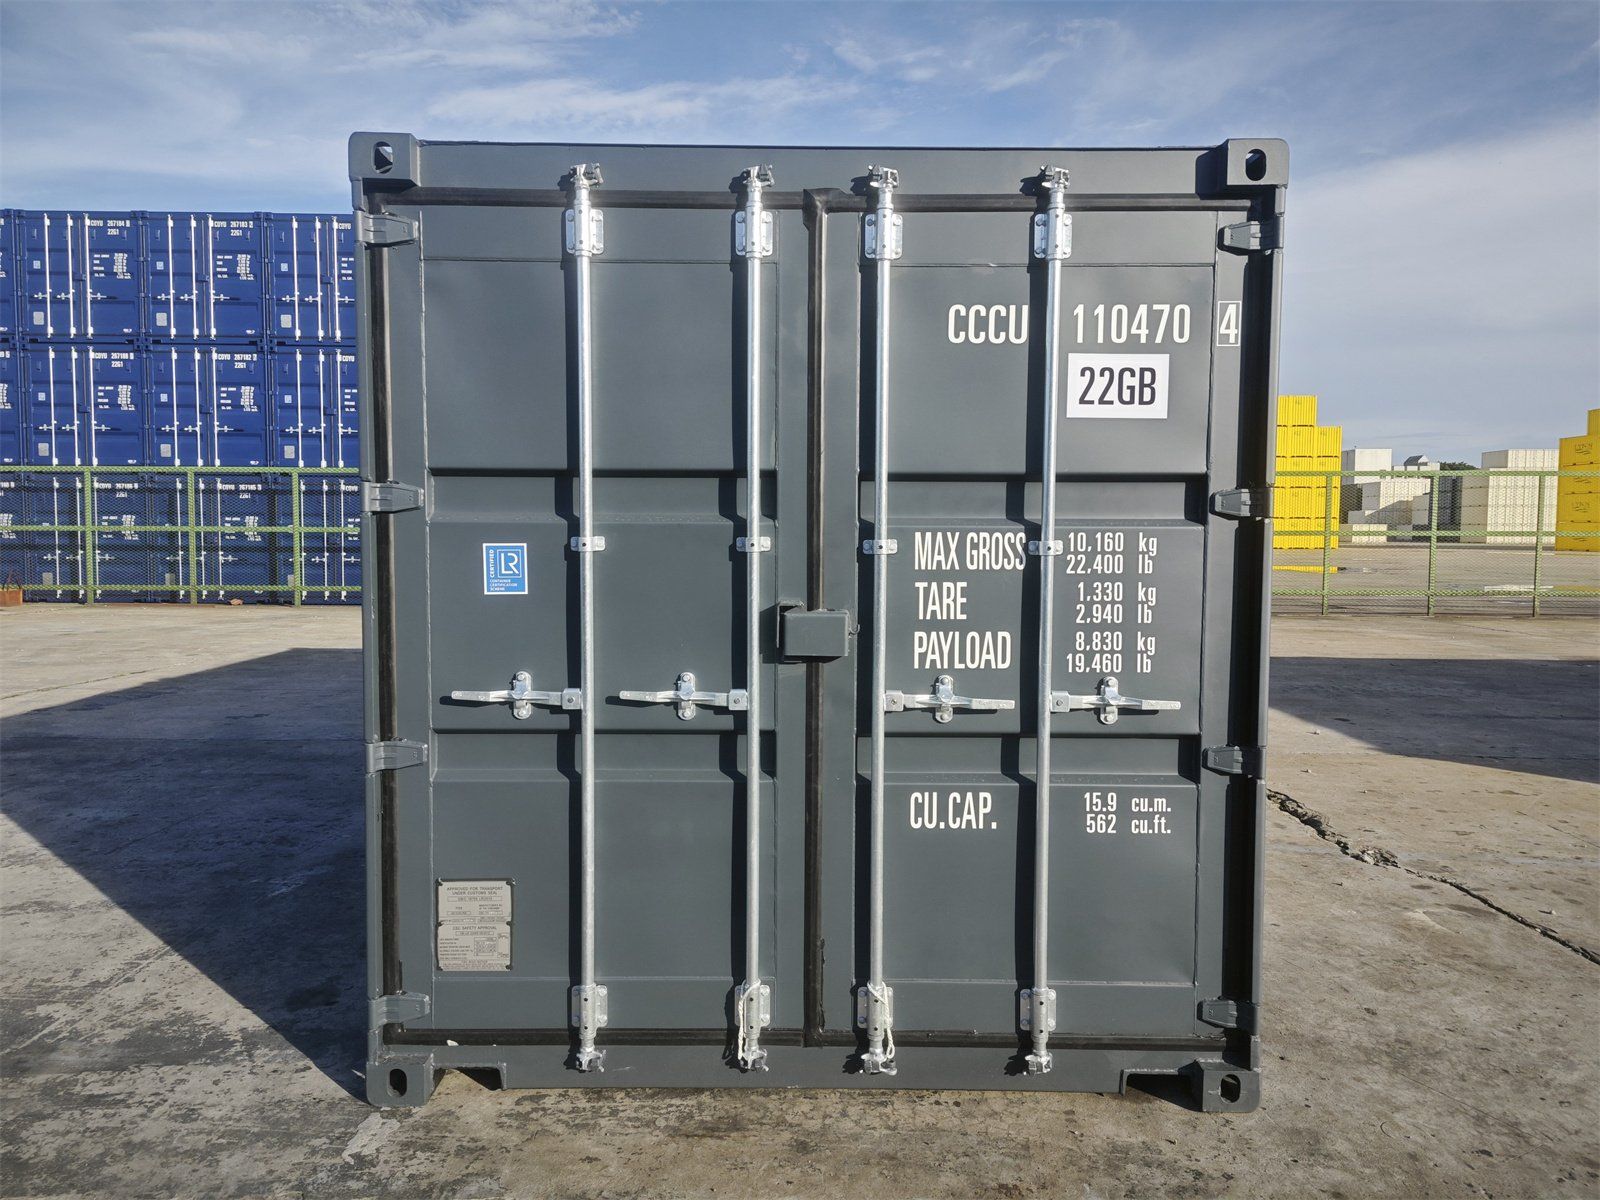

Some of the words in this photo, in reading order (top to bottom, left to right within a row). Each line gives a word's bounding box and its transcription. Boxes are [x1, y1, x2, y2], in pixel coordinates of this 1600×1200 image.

[948, 304, 1028, 344] CCCU
[1072, 304, 1190, 344] 110470
[1220, 304, 1238, 344] 4
[1078, 366, 1156, 406] 22GB
[501, 552, 519, 574] LR
[914, 532, 960, 570] MAX
[966, 532, 1026, 570] GROSS
[1068, 532, 1124, 552] 10,160
[1138, 532, 1157, 556] kg
[1066, 554, 1124, 574] 22,400
[1138, 554, 1153, 574] lb
[915, 582, 967, 620] TARE
[1078, 582, 1123, 601] 1,330
[1138, 582, 1156, 606] kg
[1076, 604, 1123, 623] 2,940
[1138, 604, 1152, 623] lb
[913, 631, 1011, 670] PAYLOAD
[1076, 632, 1122, 651] 8,830
[1137, 632, 1156, 655] kg
[1066, 653, 1122, 673] 19,460
[1137, 653, 1151, 673] lb
[910, 792, 997, 829] CU.CAP.
[1084, 792, 1117, 812] 15.9
[1131, 798, 1172, 812] cu.m.
[1086, 814, 1117, 834] 562
[1131, 814, 1172, 834] cu.ft.
